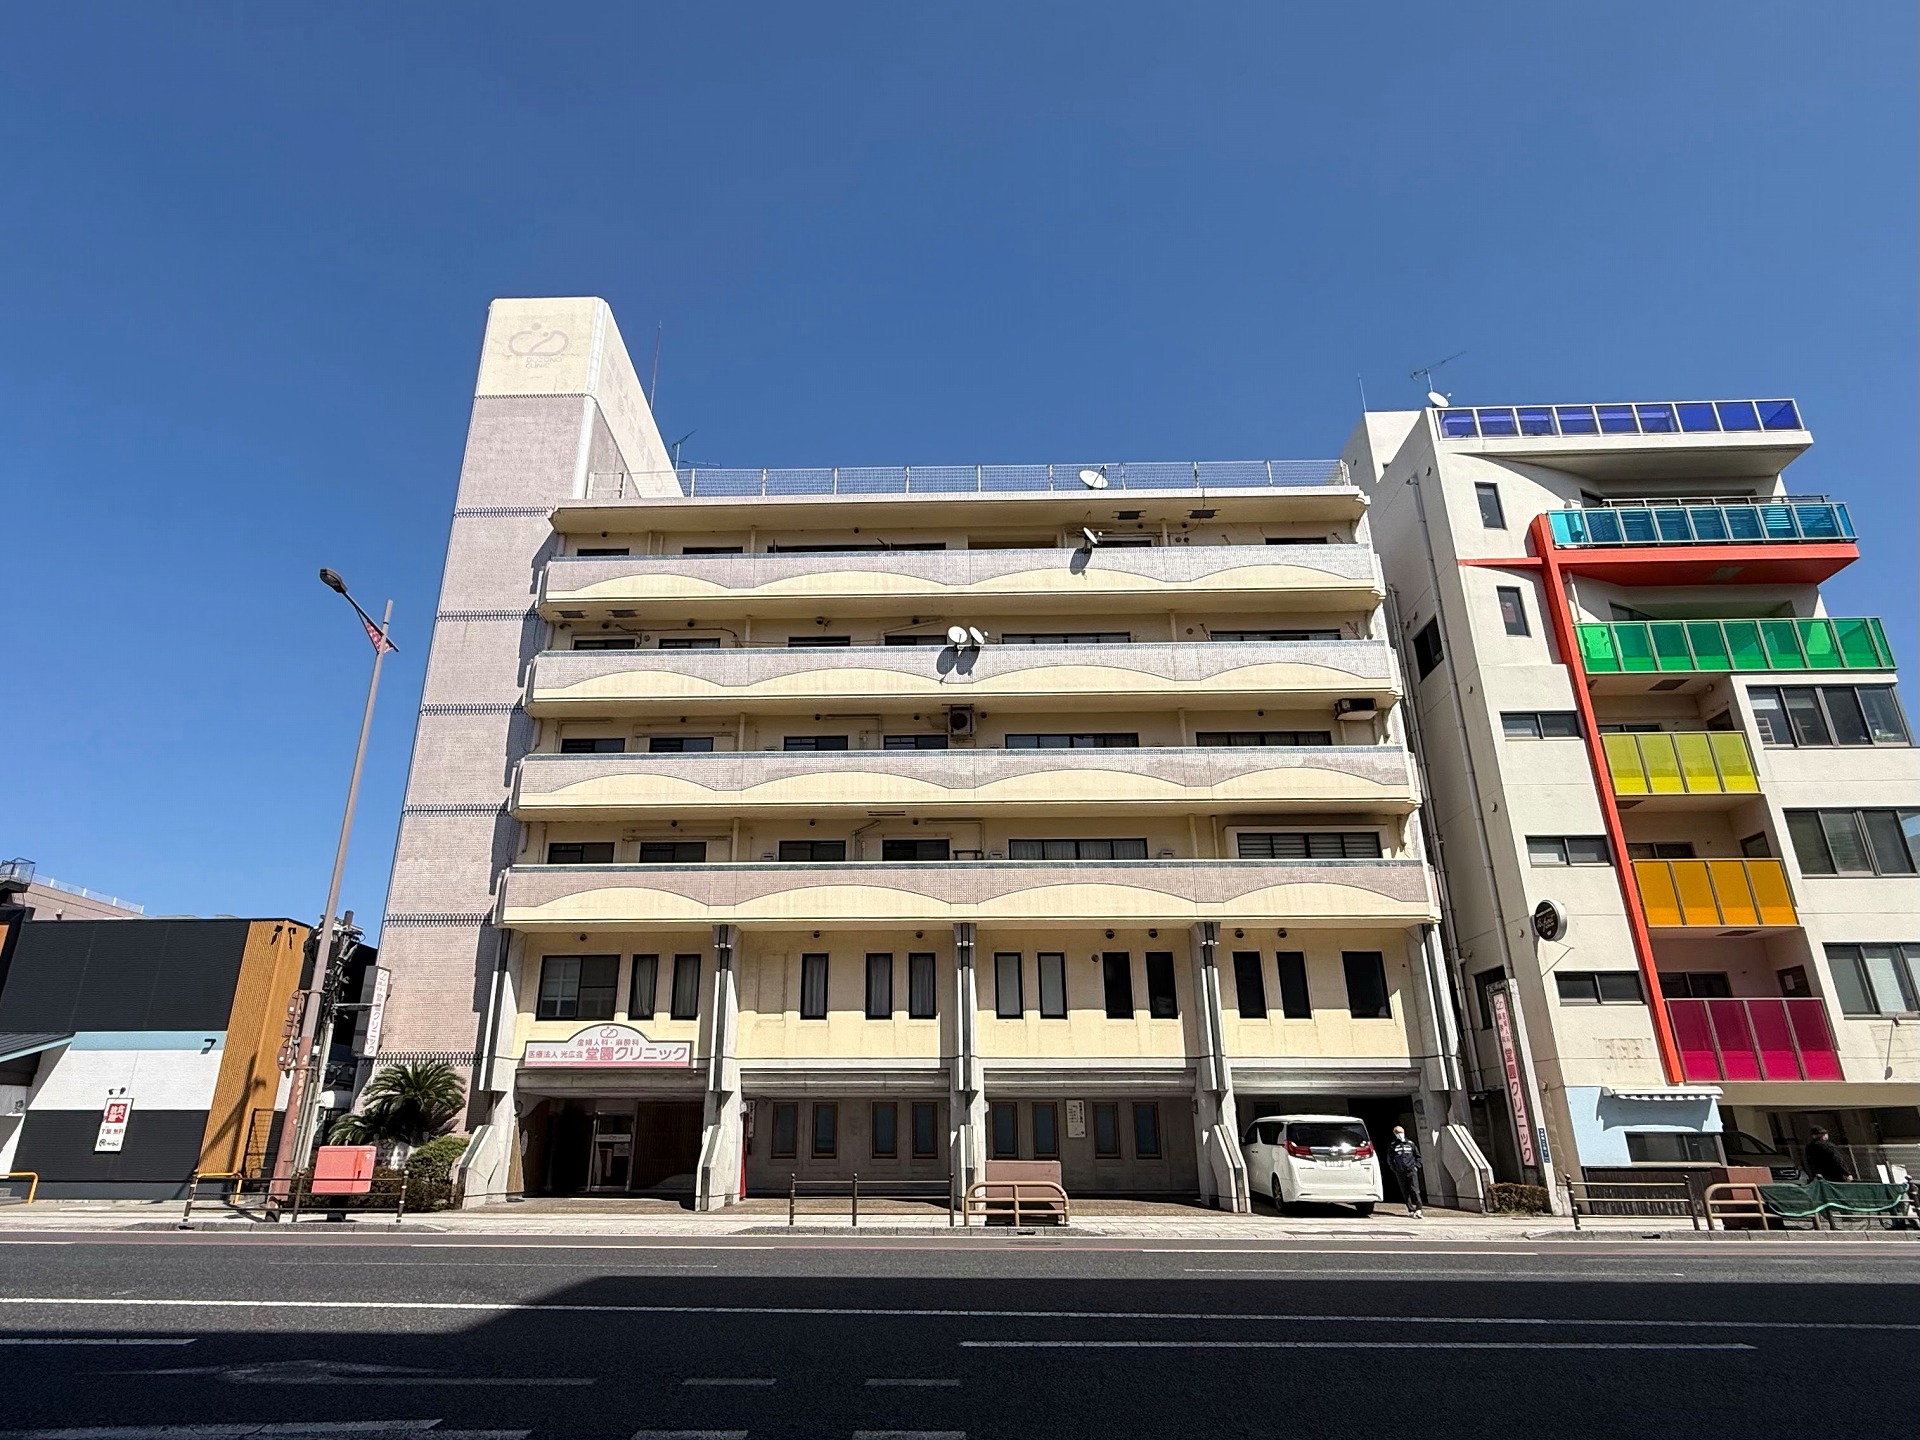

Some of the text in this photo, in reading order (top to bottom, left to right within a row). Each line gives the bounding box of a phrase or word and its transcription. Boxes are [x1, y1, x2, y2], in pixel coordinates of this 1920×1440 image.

[585, 1046, 687, 1061] 堂園クリニック
